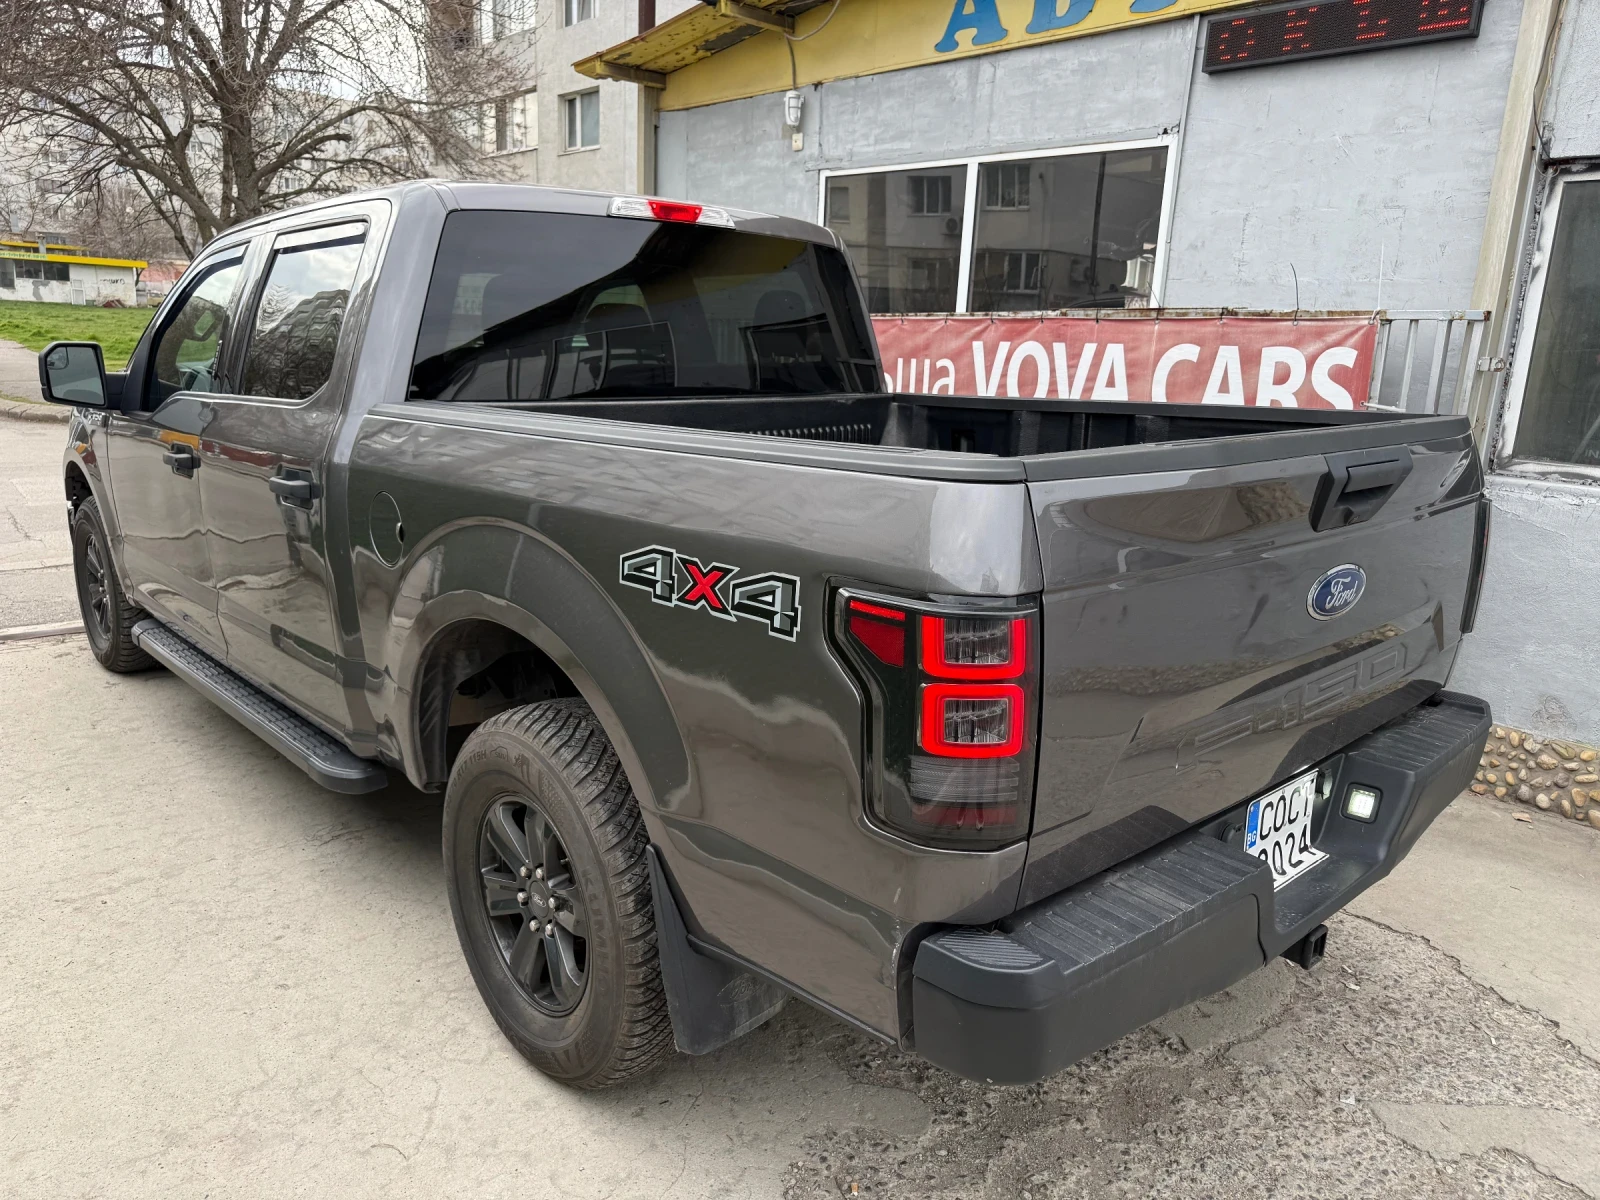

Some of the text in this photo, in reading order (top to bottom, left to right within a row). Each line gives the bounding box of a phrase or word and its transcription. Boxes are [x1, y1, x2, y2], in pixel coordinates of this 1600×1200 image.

[972, 340, 1359, 410] VOVA CARS
[1325, 576, 1358, 609] Ford
[1247, 831, 1257, 845] BG
